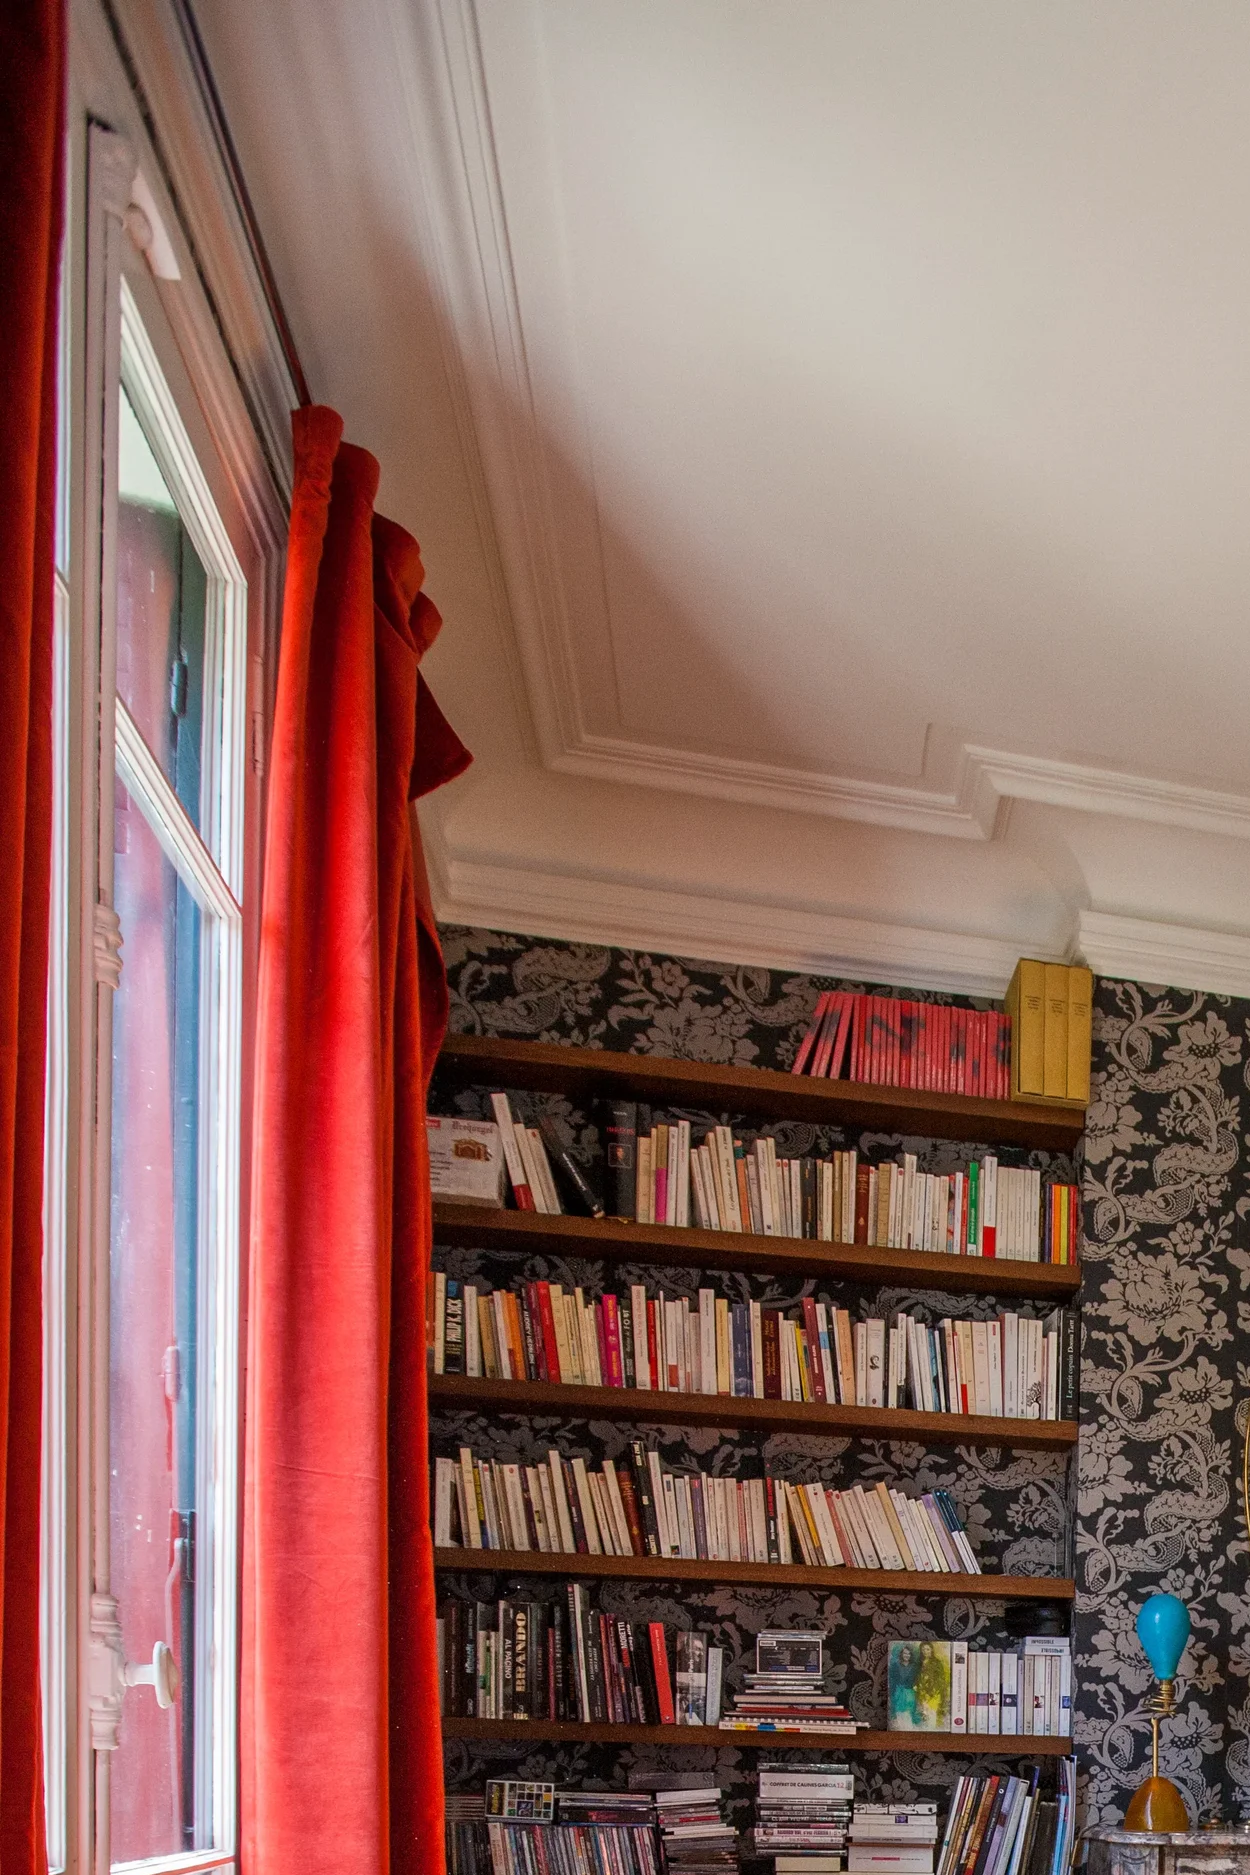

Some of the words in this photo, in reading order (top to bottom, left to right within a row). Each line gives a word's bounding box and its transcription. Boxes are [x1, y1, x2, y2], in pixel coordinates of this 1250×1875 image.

[448, 1299, 461, 1314] DICK
[447, 1322, 461, 1342] PHILIP
[522, 1311, 532, 1335] AUDREY
[1066, 1354, 1074, 1374] copain
[1066, 1375, 1074, 1389] petit
[1066, 1390, 1073, 1398] Le
[504, 1639, 512, 1649] AL
[617, 1622, 628, 1649] MORETTI
[515, 1612, 527, 1692] BRANDO
[504, 1651, 512, 1679] PACINO
